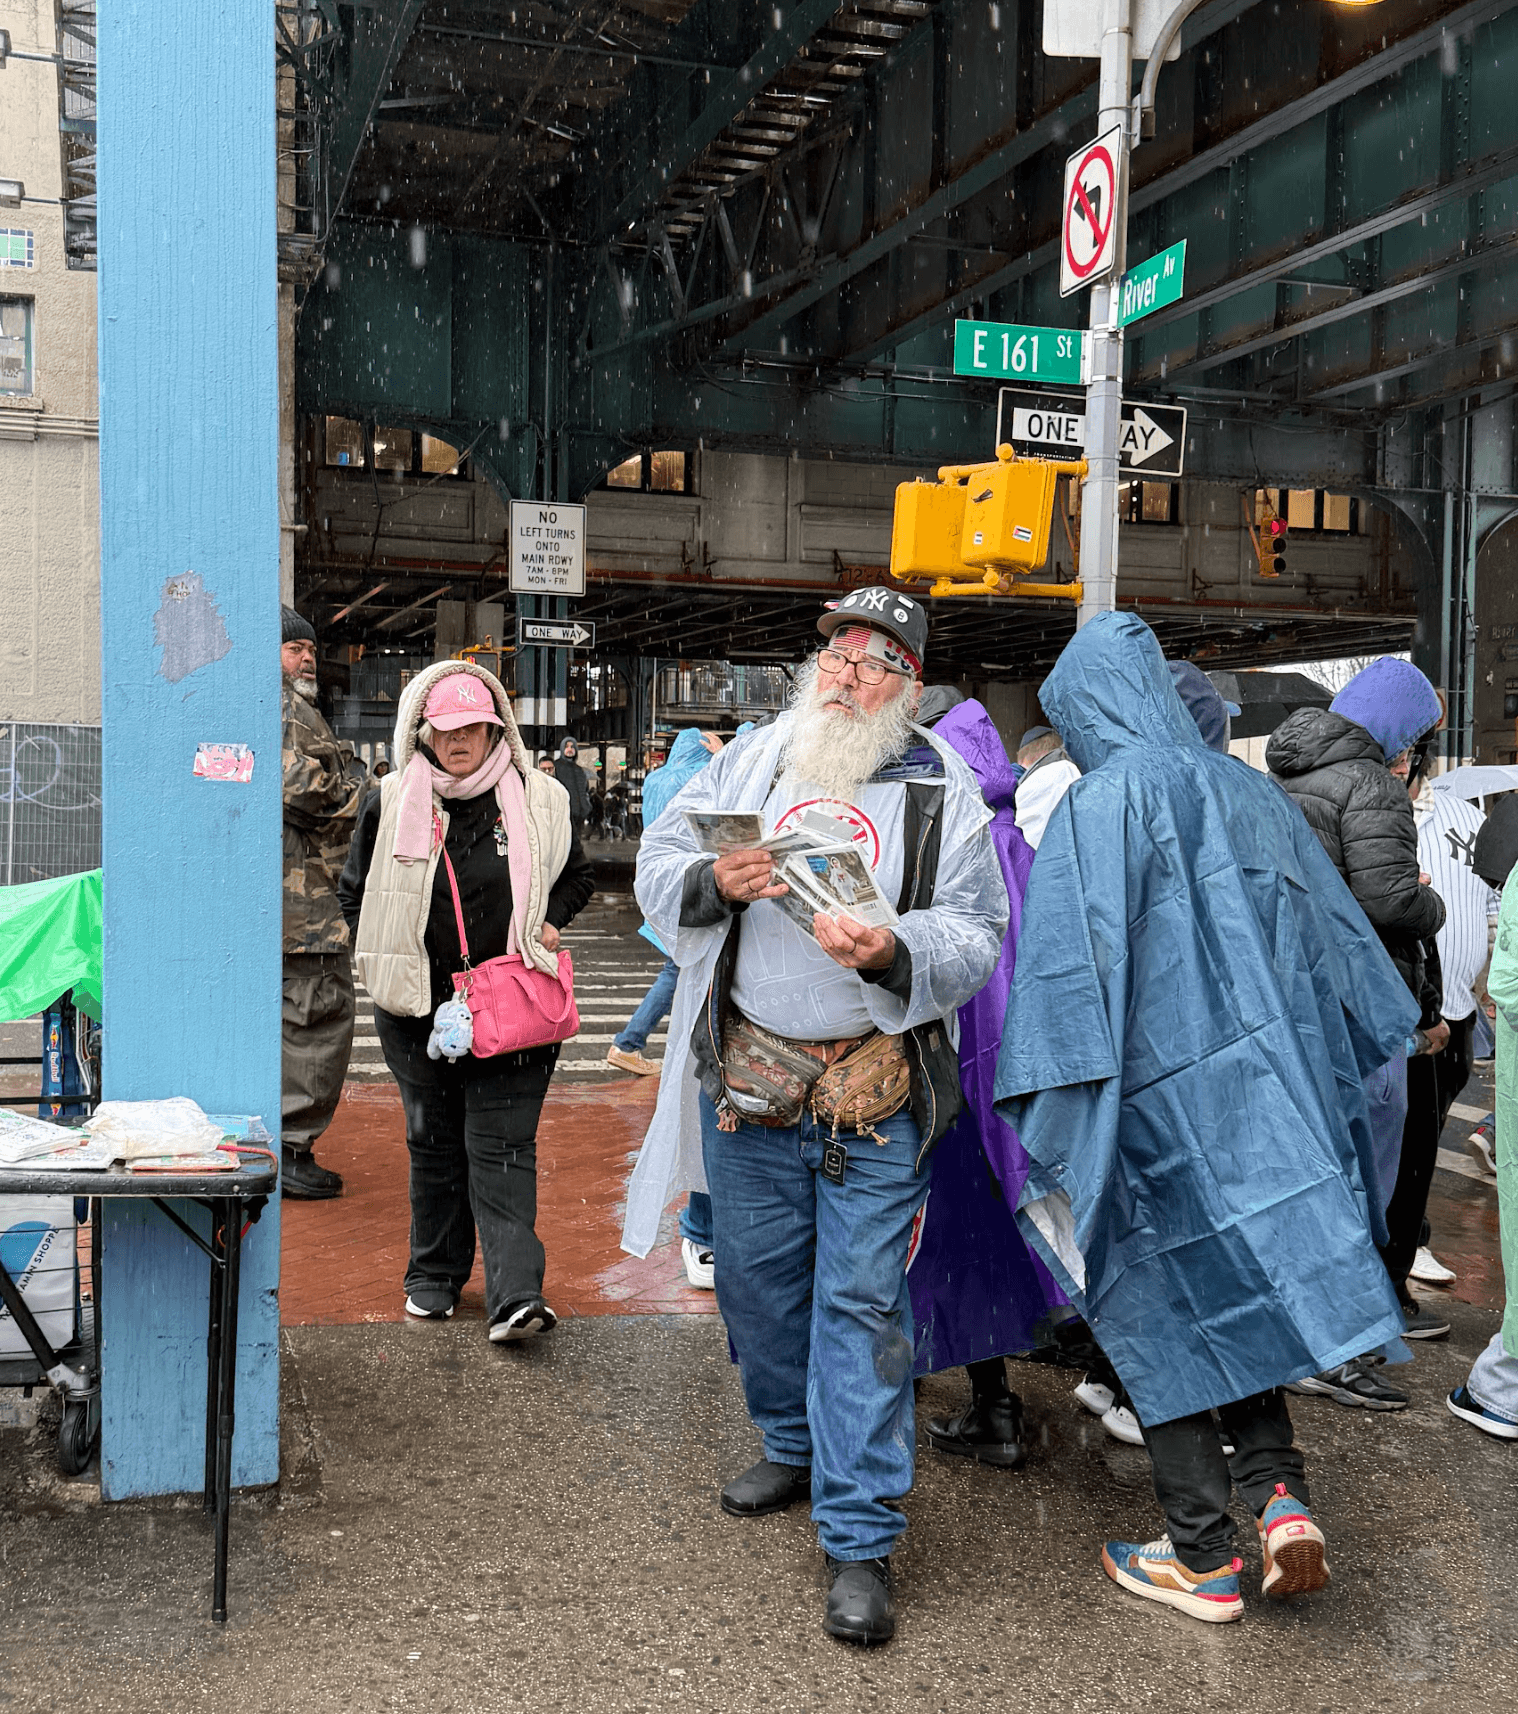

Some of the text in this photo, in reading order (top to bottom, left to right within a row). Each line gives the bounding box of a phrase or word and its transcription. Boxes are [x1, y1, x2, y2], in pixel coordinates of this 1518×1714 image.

[1122, 254, 1176, 319] River Av
[973, 329, 1073, 373] E 161 St
[1027, 413, 1157, 451] ONE AY
[539, 511, 558, 524] NO
[520, 527, 576, 540] LEFT TURNS
[535, 541, 560, 552] ONTO
[521, 553, 574, 566] MAIN RDWY
[526, 566, 544, 574] 7AM
[551, 567, 569, 576] 8PM
[527, 576, 546, 584] MON
[554, 577, 567, 585] FRI
[859, 588, 889, 612] NY
[531, 627, 583, 640] ONE WAY
[457, 684, 477, 703] NY
[34, 1225, 61, 1264] SHOPPE
